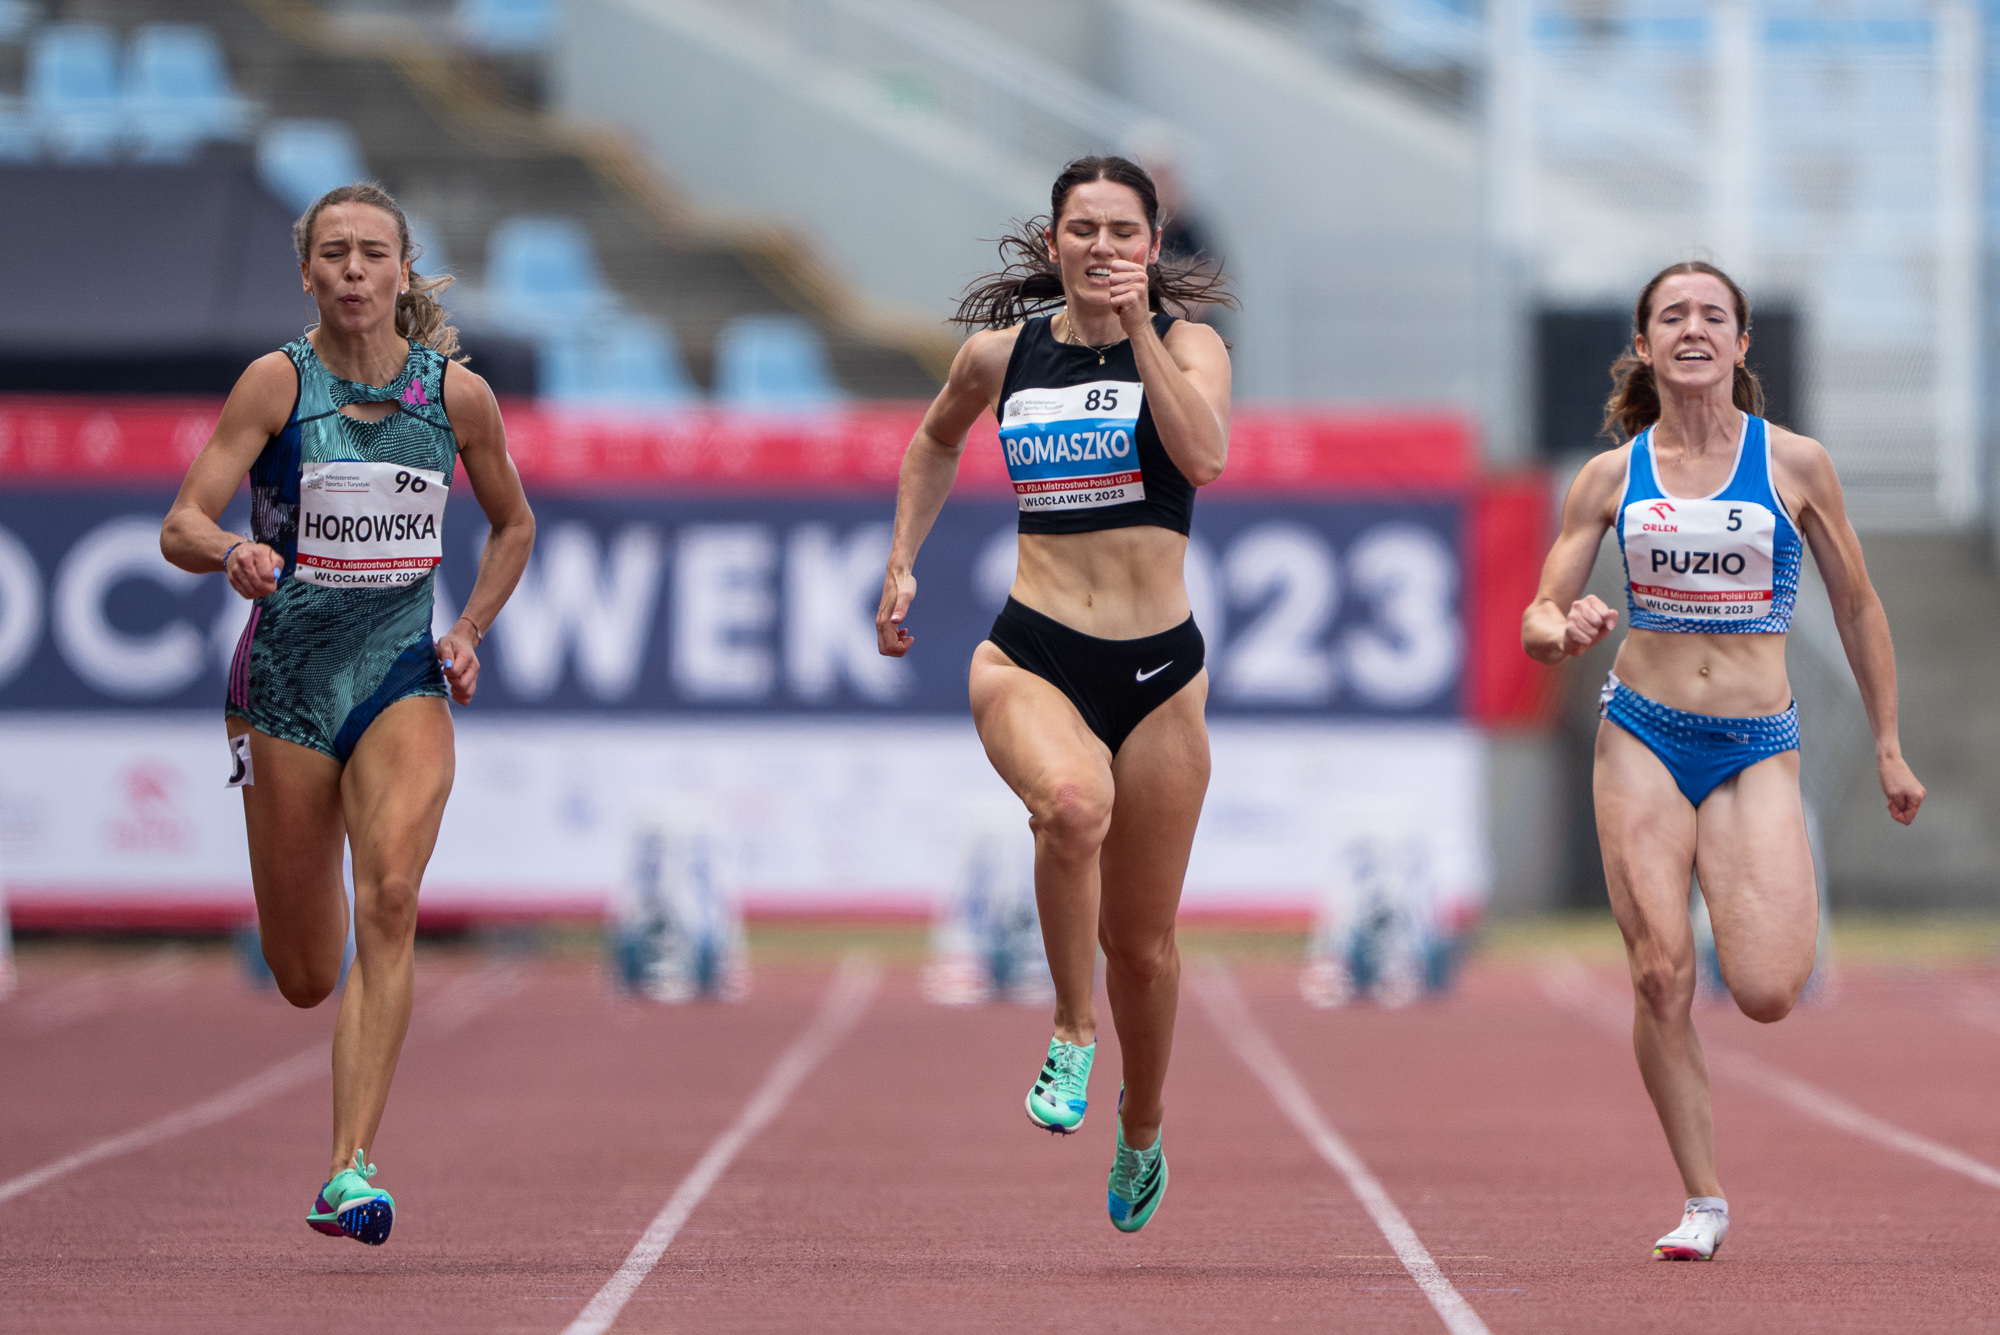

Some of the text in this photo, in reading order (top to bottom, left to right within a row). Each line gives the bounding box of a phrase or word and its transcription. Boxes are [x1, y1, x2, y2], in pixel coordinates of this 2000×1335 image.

[1085, 389, 1118, 411] 85
[1006, 429, 1130, 466] ROMASZKO
[395, 471, 427, 493] 96
[1027, 484, 1042, 492] PZLA
[1043, 482, 1089, 491] Mistrzostwa
[1090, 476, 1114, 487] Polski
[1115, 474, 1132, 484] U23
[1024, 489, 1125, 506] WŁOCŁAWEK 2023
[305, 512, 436, 542] HOROWSKA
[1642, 509, 1742, 532] ORLEN 5
[307, 557, 433, 570] 40. PZLA Mistrzostwa Polski U23
[1651, 548, 1746, 575] PUZIO
[315, 571, 423, 583] WŁOCŁAWEK 202
[1670, 591, 1719, 600] Mistrzostwa
[1721, 591, 1745, 600] Polski
[1748, 591, 1763, 600] U23
[1646, 599, 1753, 615] WŁOCŁAWEK 2023
